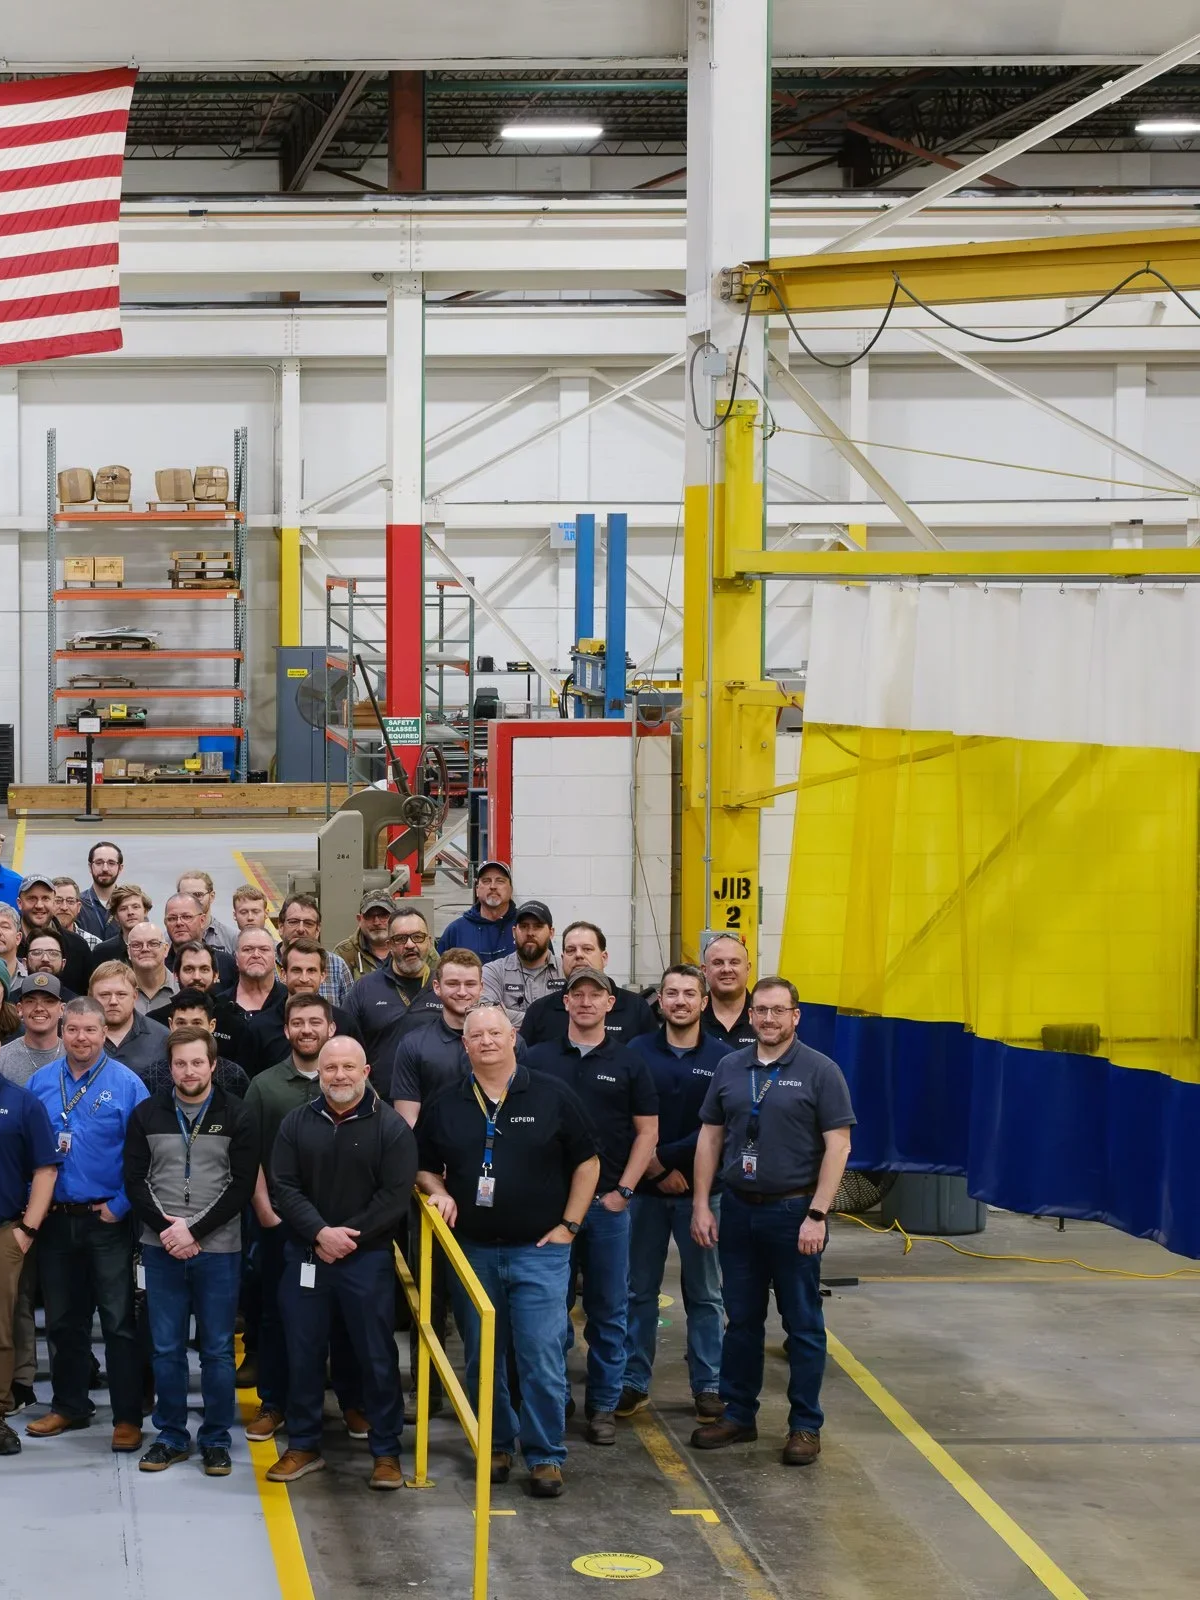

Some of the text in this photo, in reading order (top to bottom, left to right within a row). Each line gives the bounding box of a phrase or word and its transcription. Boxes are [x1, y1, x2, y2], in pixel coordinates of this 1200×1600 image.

[713, 877, 751, 900] JIB
[726, 905, 741, 929] 2
[596, 1074, 616, 1083] CEPEDA
[778, 1079, 802, 1087] CEPEDA
[756, 1079, 773, 1103] CEPEDA
